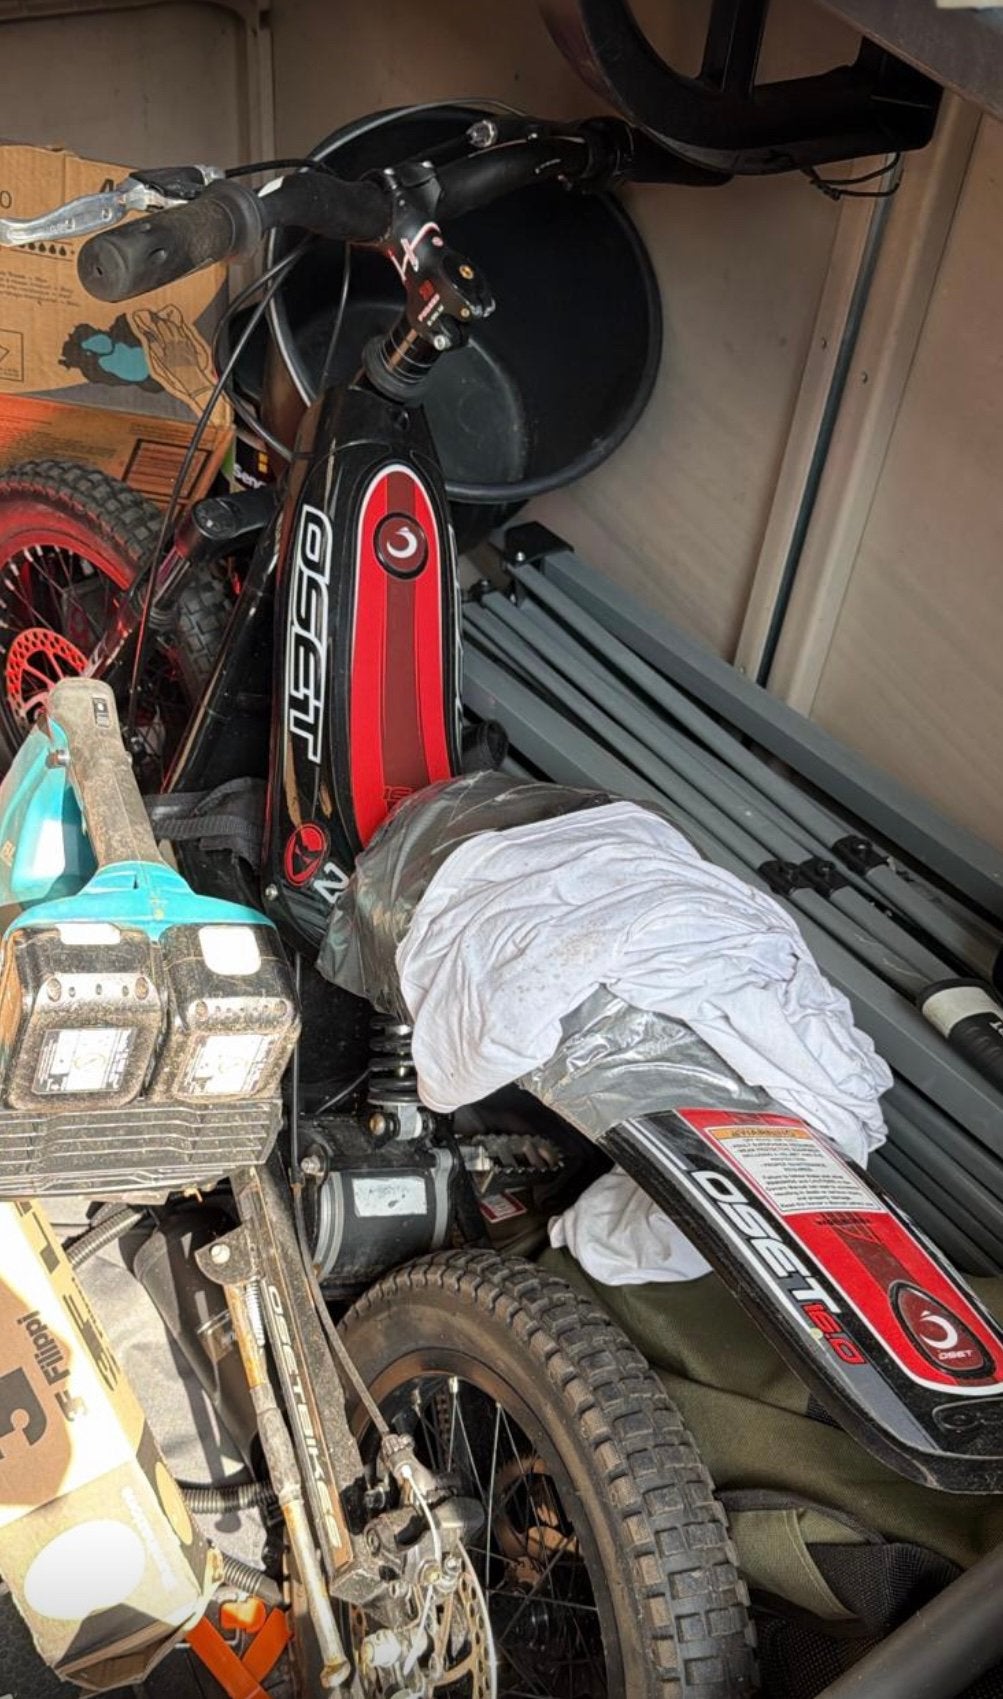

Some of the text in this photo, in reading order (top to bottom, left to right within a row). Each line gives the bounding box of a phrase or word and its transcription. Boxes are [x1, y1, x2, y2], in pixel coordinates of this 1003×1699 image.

[288, 504, 333, 765] OSET
[690, 1170, 842, 1314] OSET
[16, 1310, 71, 1386] Filippi
